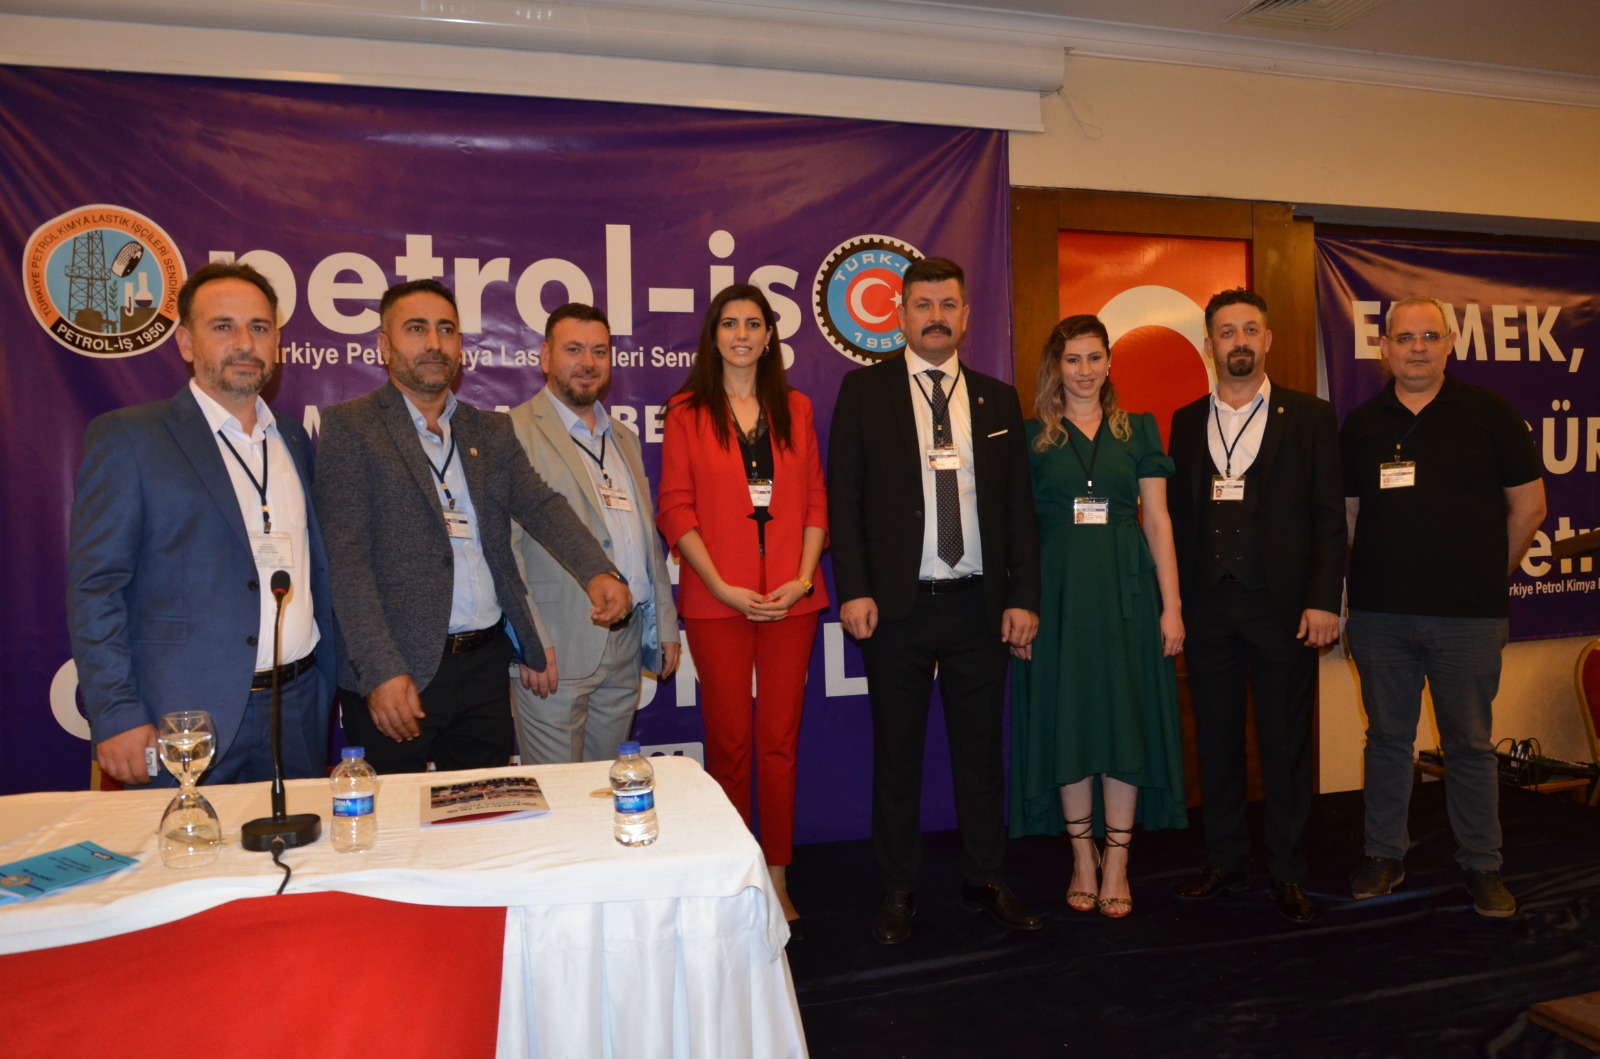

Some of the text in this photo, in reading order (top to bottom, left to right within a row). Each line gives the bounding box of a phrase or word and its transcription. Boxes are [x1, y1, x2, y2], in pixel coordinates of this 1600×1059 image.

[32, 232, 58, 269] PETROL
[56, 215, 90, 236] KİMYA
[92, 214, 129, 227] LASTİK
[131, 219, 170, 256] İŞÇİLERİ
[163, 258, 178, 314] SENDİKASI
[57, 322, 165, 351] PETROL-İŞ 1950
[854, 332, 906, 349] 1952
[1351, 300, 1585, 373] EMEK,
[1509, 583, 1533, 599] rkiye
[1536, 580, 1564, 594] Petrol
[1567, 579, 1596, 593] Kimya
